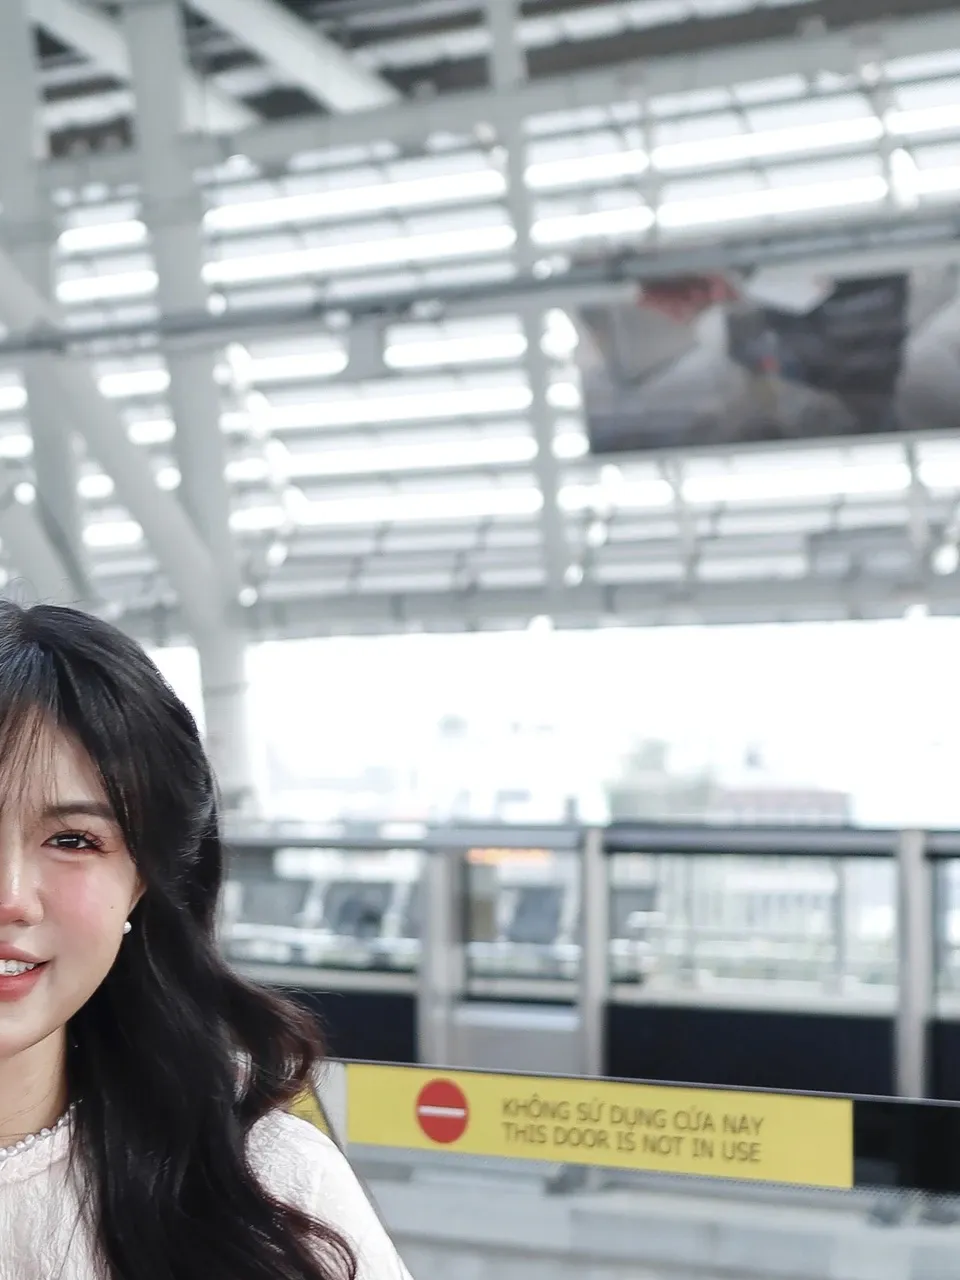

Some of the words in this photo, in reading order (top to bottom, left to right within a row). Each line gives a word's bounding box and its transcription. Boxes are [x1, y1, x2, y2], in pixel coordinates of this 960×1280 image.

[501, 1093, 570, 1121] KHÔNG
[502, 1121, 547, 1144] THIS
[553, 1125, 610, 1150] DOOR
[616, 1129, 636, 1152] IS
[642, 1134, 686, 1156] NOT
[692, 1137, 715, 1160] IN
[721, 1140, 762, 1163] USE
